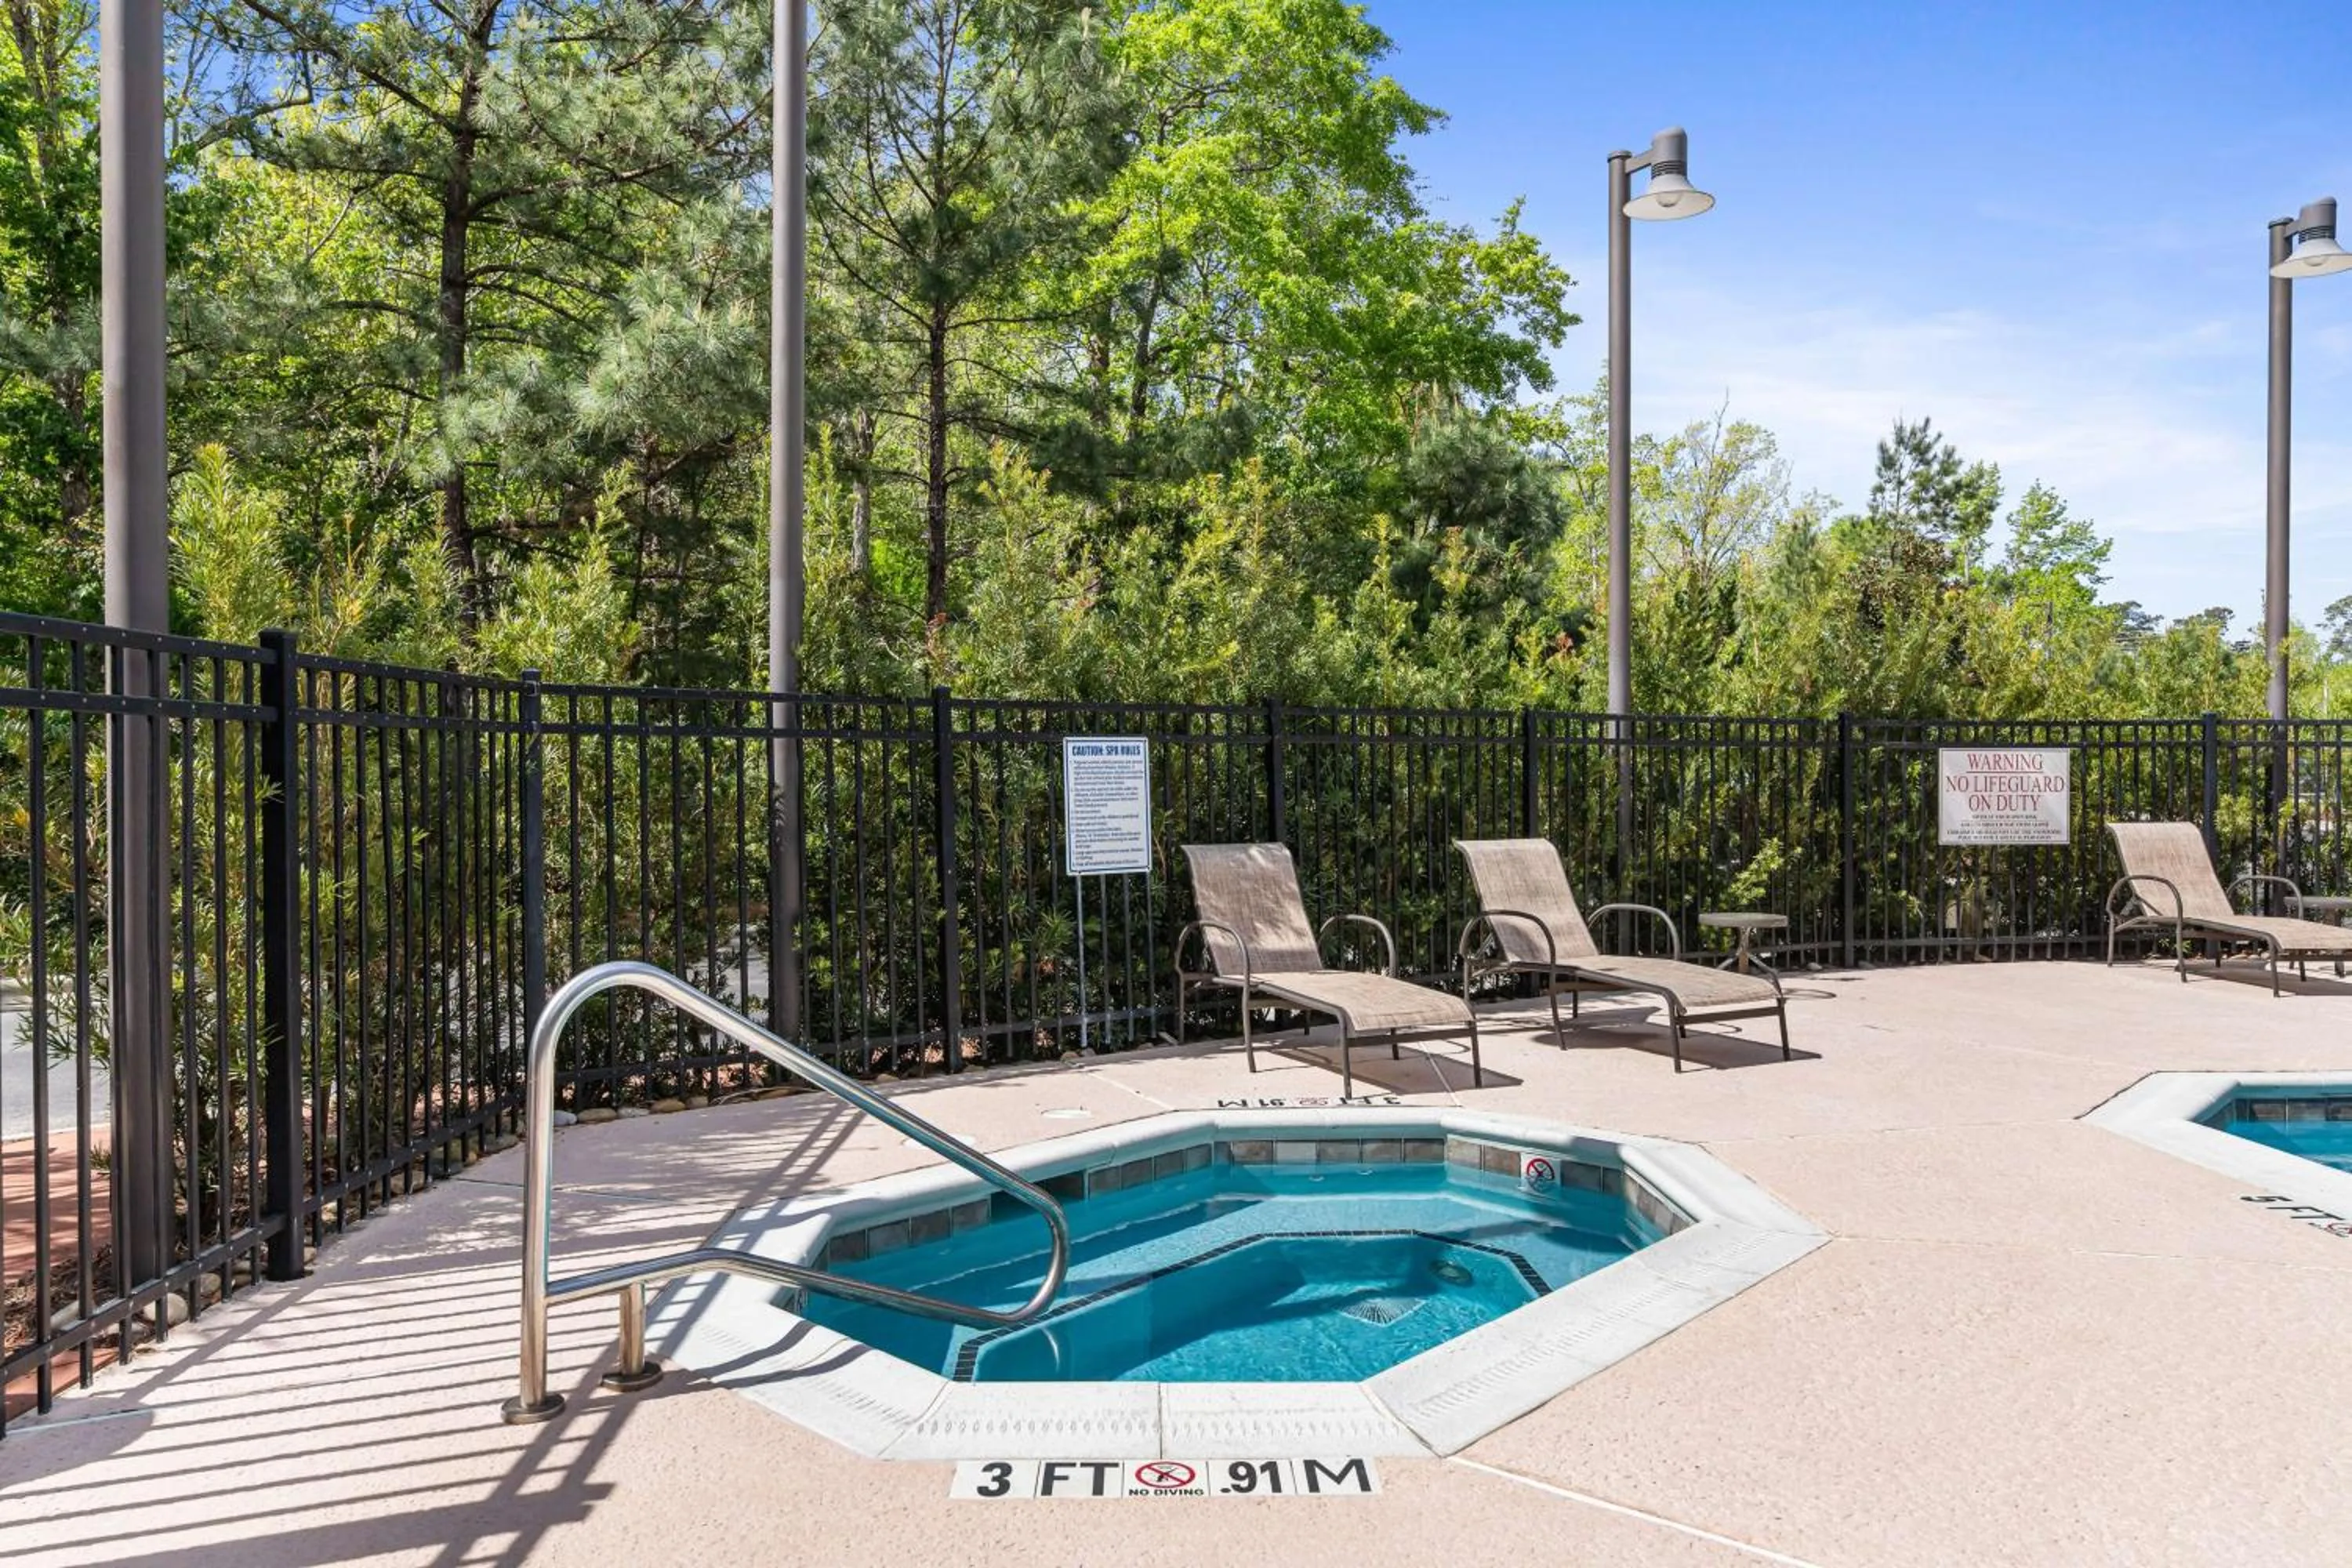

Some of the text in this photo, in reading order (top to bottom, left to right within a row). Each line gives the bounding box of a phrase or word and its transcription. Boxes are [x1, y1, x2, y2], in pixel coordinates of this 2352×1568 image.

[1966, 753, 2043, 771] WARNING
[1946, 775, 2065, 793] NO LIFEGUARD
[1969, 794, 2042, 811] ON DUTY
[2266, 1206, 2346, 1221] FT
[976, 1458, 1373, 1497] 3 FT .91 M
